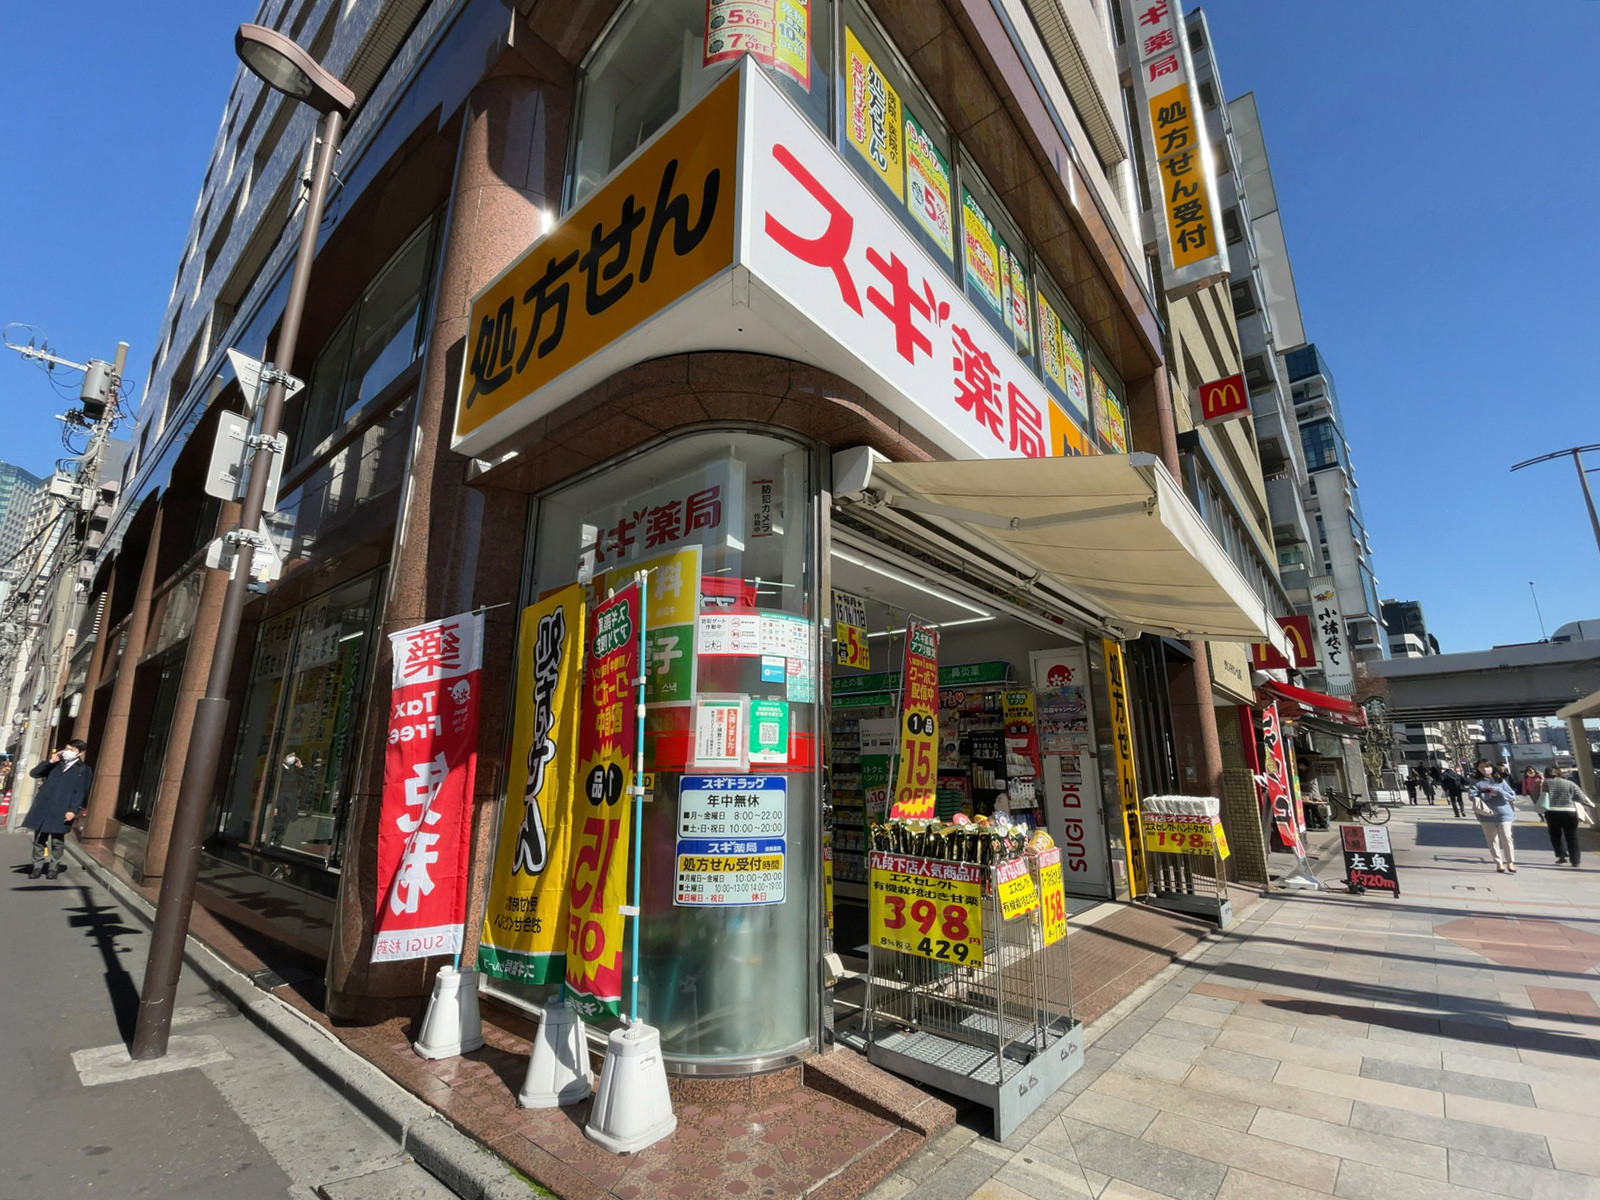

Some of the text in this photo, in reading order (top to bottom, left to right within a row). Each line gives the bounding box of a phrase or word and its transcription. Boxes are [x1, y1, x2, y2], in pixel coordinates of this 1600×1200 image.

[1135, 0, 1179, 82] ギ薬局
[867, 62, 887, 171] 処方せん
[1157, 100, 1207, 252] 処方せん受付
[466, 158, 720, 406] 処方せん
[764, 143, 1046, 457] スギ薬局
[761, 485, 771, 532] 防犯カメラ
[909, 666, 937, 686] クーポン
[951, 667, 981, 678] 鼻炎薬
[1108, 652, 1143, 884] 処方せん受付
[632, 776, 652, 787] AD
[702, 777, 768, 789] スギドラッグ
[707, 794, 760, 808] 年中無休
[899, 788, 932, 805] OFF
[1145, 822, 1213, 834] エスセレクトハンドタオル
[708, 841, 757, 853] スギ薬局
[1066, 818, 1087, 873] SUGI
[871, 854, 980, 882] 九段下店人気商品!!
[1349, 853, 1390, 873] 左奥
[684, 884, 704, 892] 土曜日
[889, 873, 959, 890] エスセレクト
[1350, 869, 1396, 889] 約20m
[752, 892, 767, 901] 休日
[872, 880, 980, 907] 有機栽培むき甘栗
[1044, 889, 1063, 928] 158
